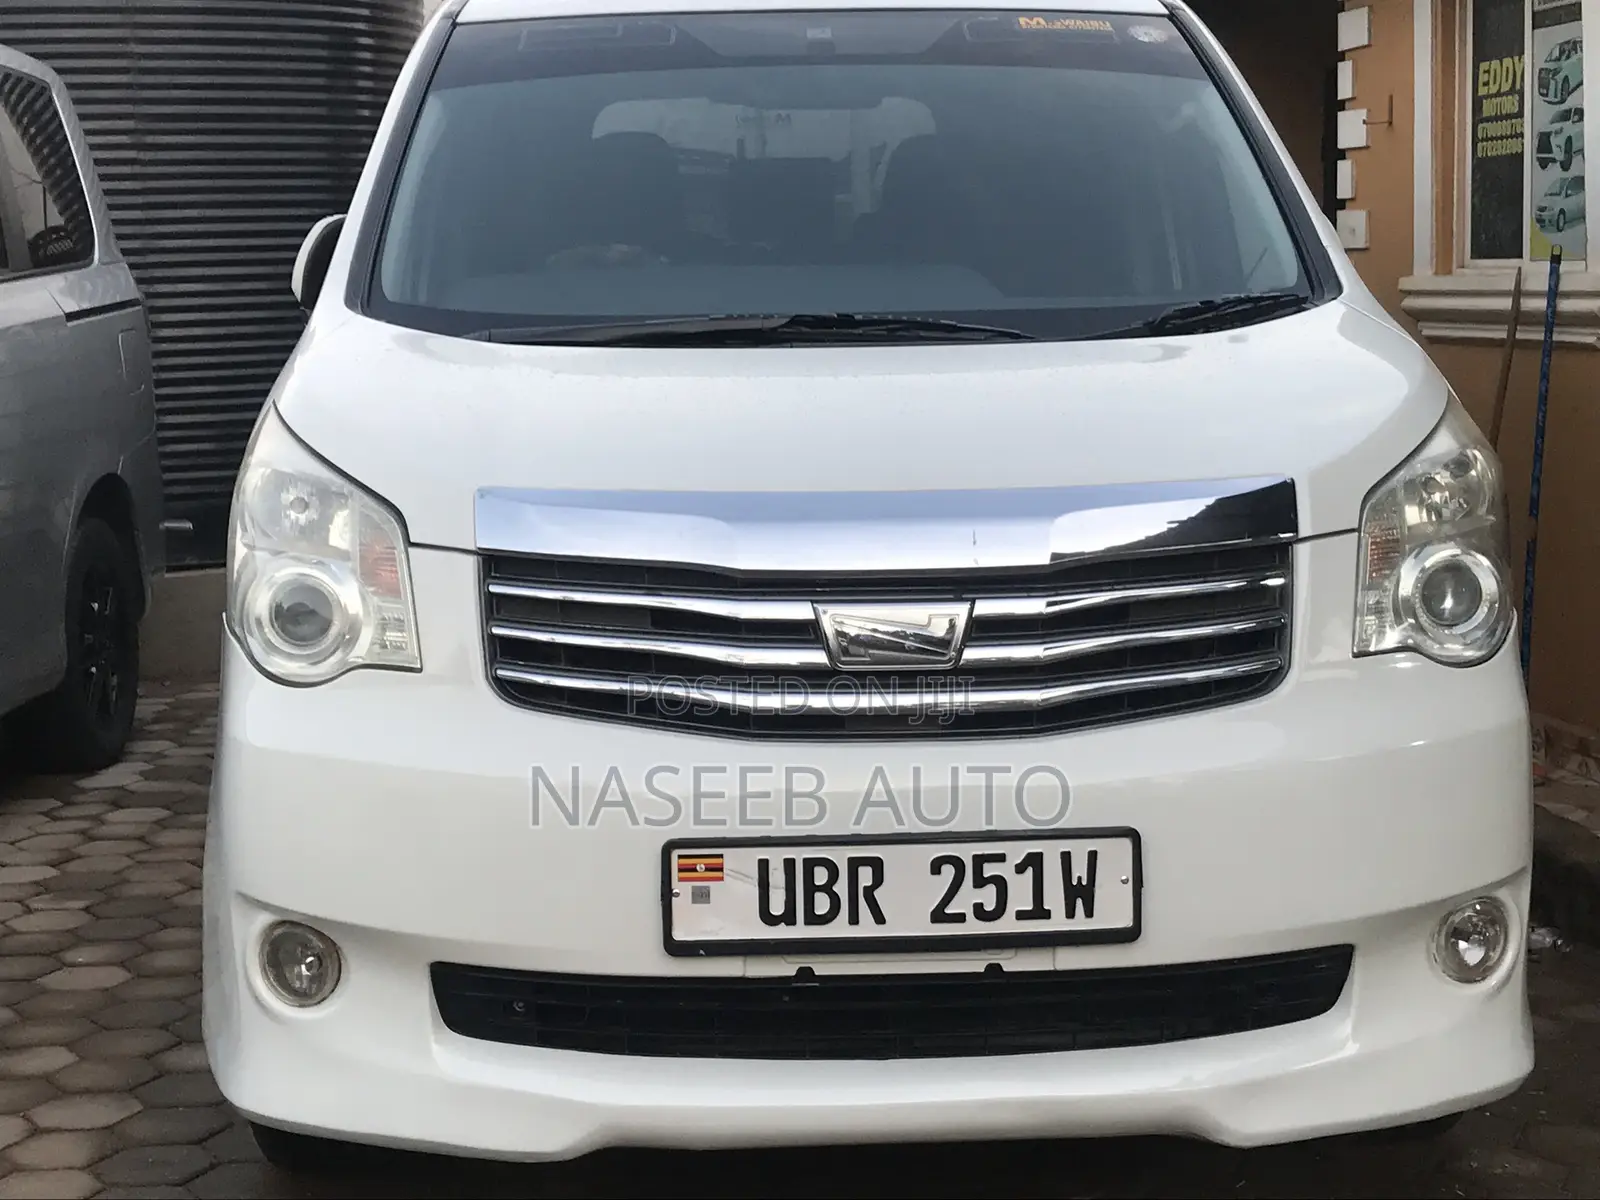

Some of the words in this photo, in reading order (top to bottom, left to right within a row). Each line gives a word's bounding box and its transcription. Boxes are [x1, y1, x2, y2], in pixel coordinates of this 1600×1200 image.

[1478, 56, 1524, 96] EDDY
[1483, 95, 1519, 117] MOTORS
[758, 856, 887, 926] UBR
[930, 850, 1098, 924] 251W
